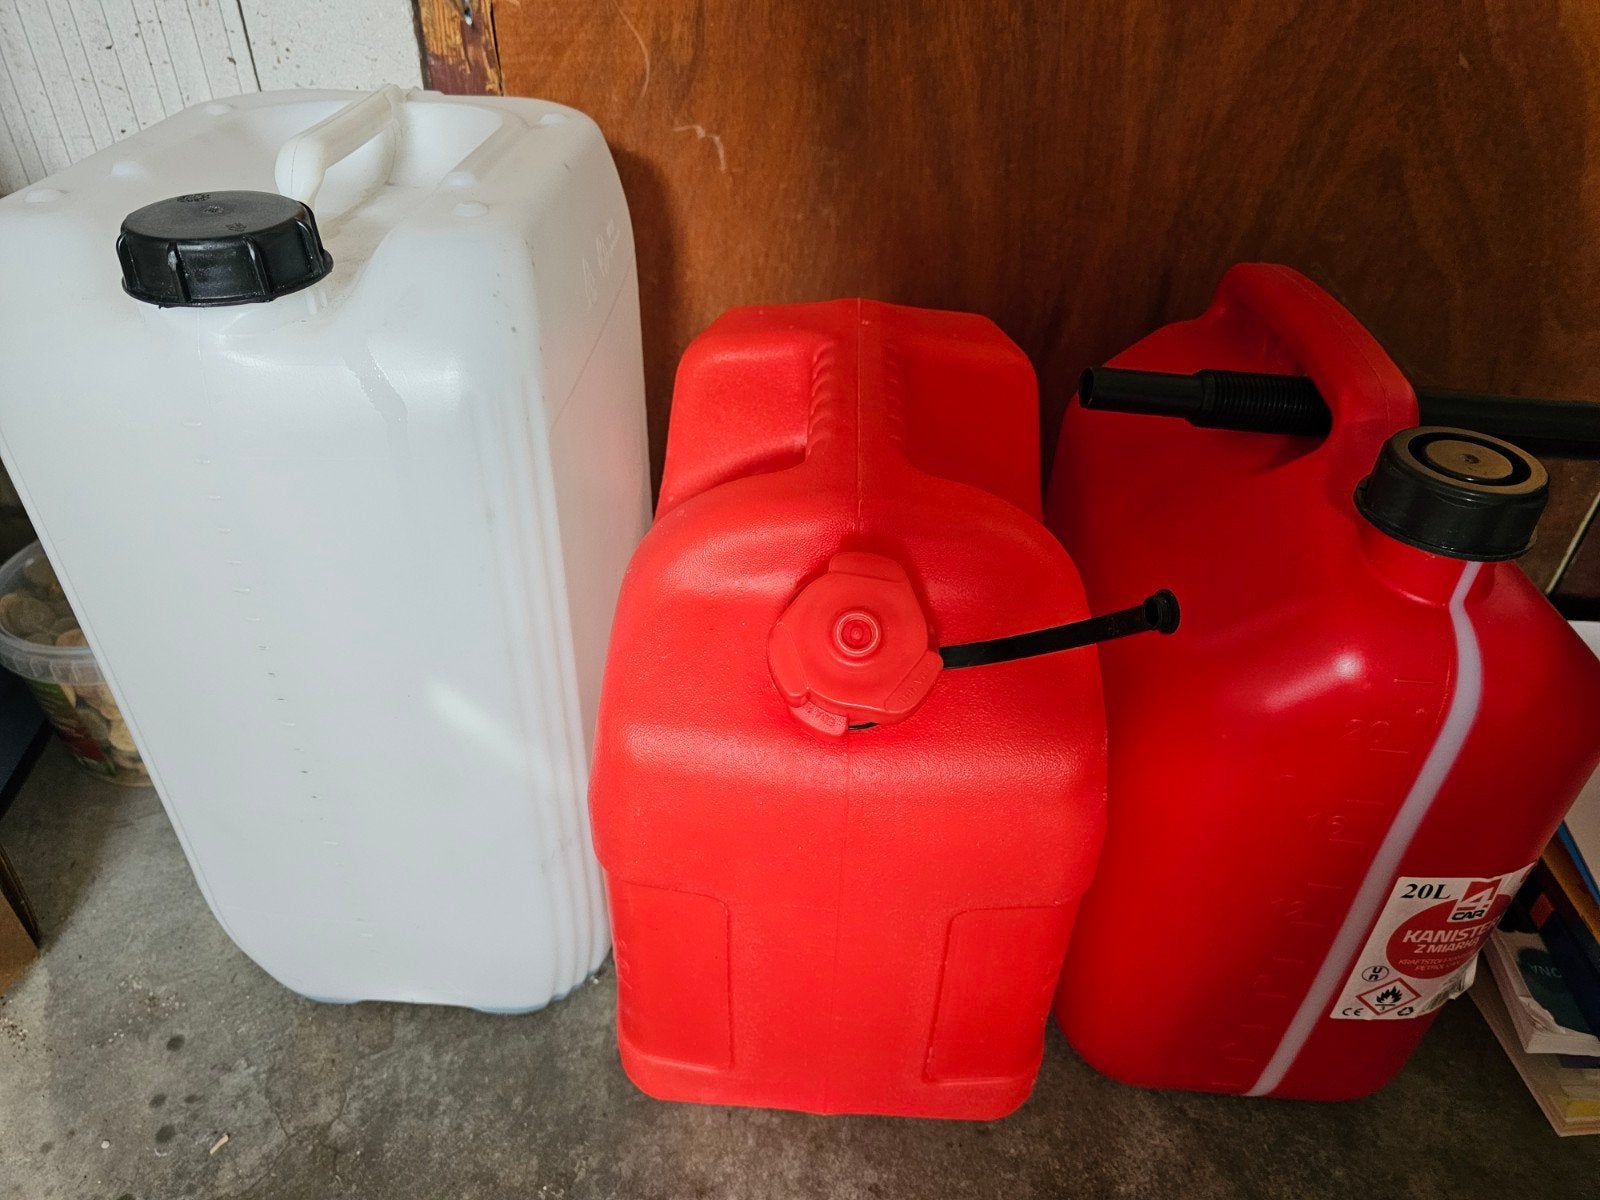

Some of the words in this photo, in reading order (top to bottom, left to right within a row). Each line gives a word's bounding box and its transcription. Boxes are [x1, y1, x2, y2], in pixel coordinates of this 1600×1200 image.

[1401, 883, 1450, 899] 20L
[1452, 909, 1484, 921] CAR
[1413, 944, 1427, 953] Z
